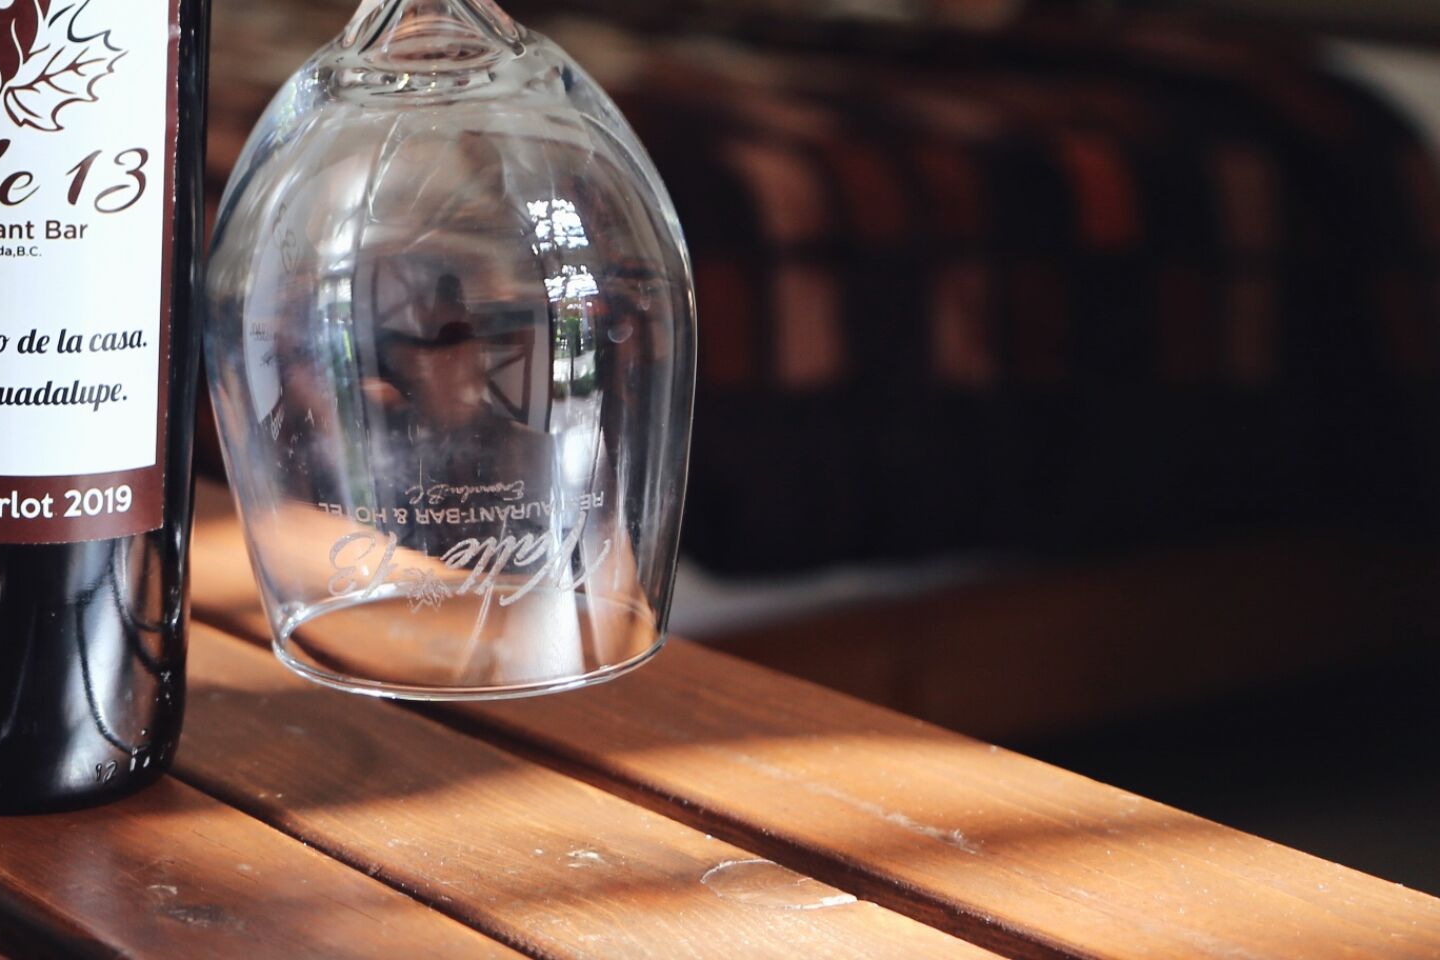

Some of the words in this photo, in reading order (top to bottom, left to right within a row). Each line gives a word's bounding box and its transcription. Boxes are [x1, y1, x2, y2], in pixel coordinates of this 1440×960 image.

[66, 147, 150, 214] 13
[45, 220, 88, 241] Bar
[17, 328, 48, 354] de
[56, 328, 83, 354] la
[88, 328, 148, 352] casa.
[63, 484, 133, 518] 2019
[393, 507, 408, 524] &
[416, 490, 605, 525] REAURANT-BAR
[328, 528, 398, 599] 13
[440, 512, 611, 607] Valle
